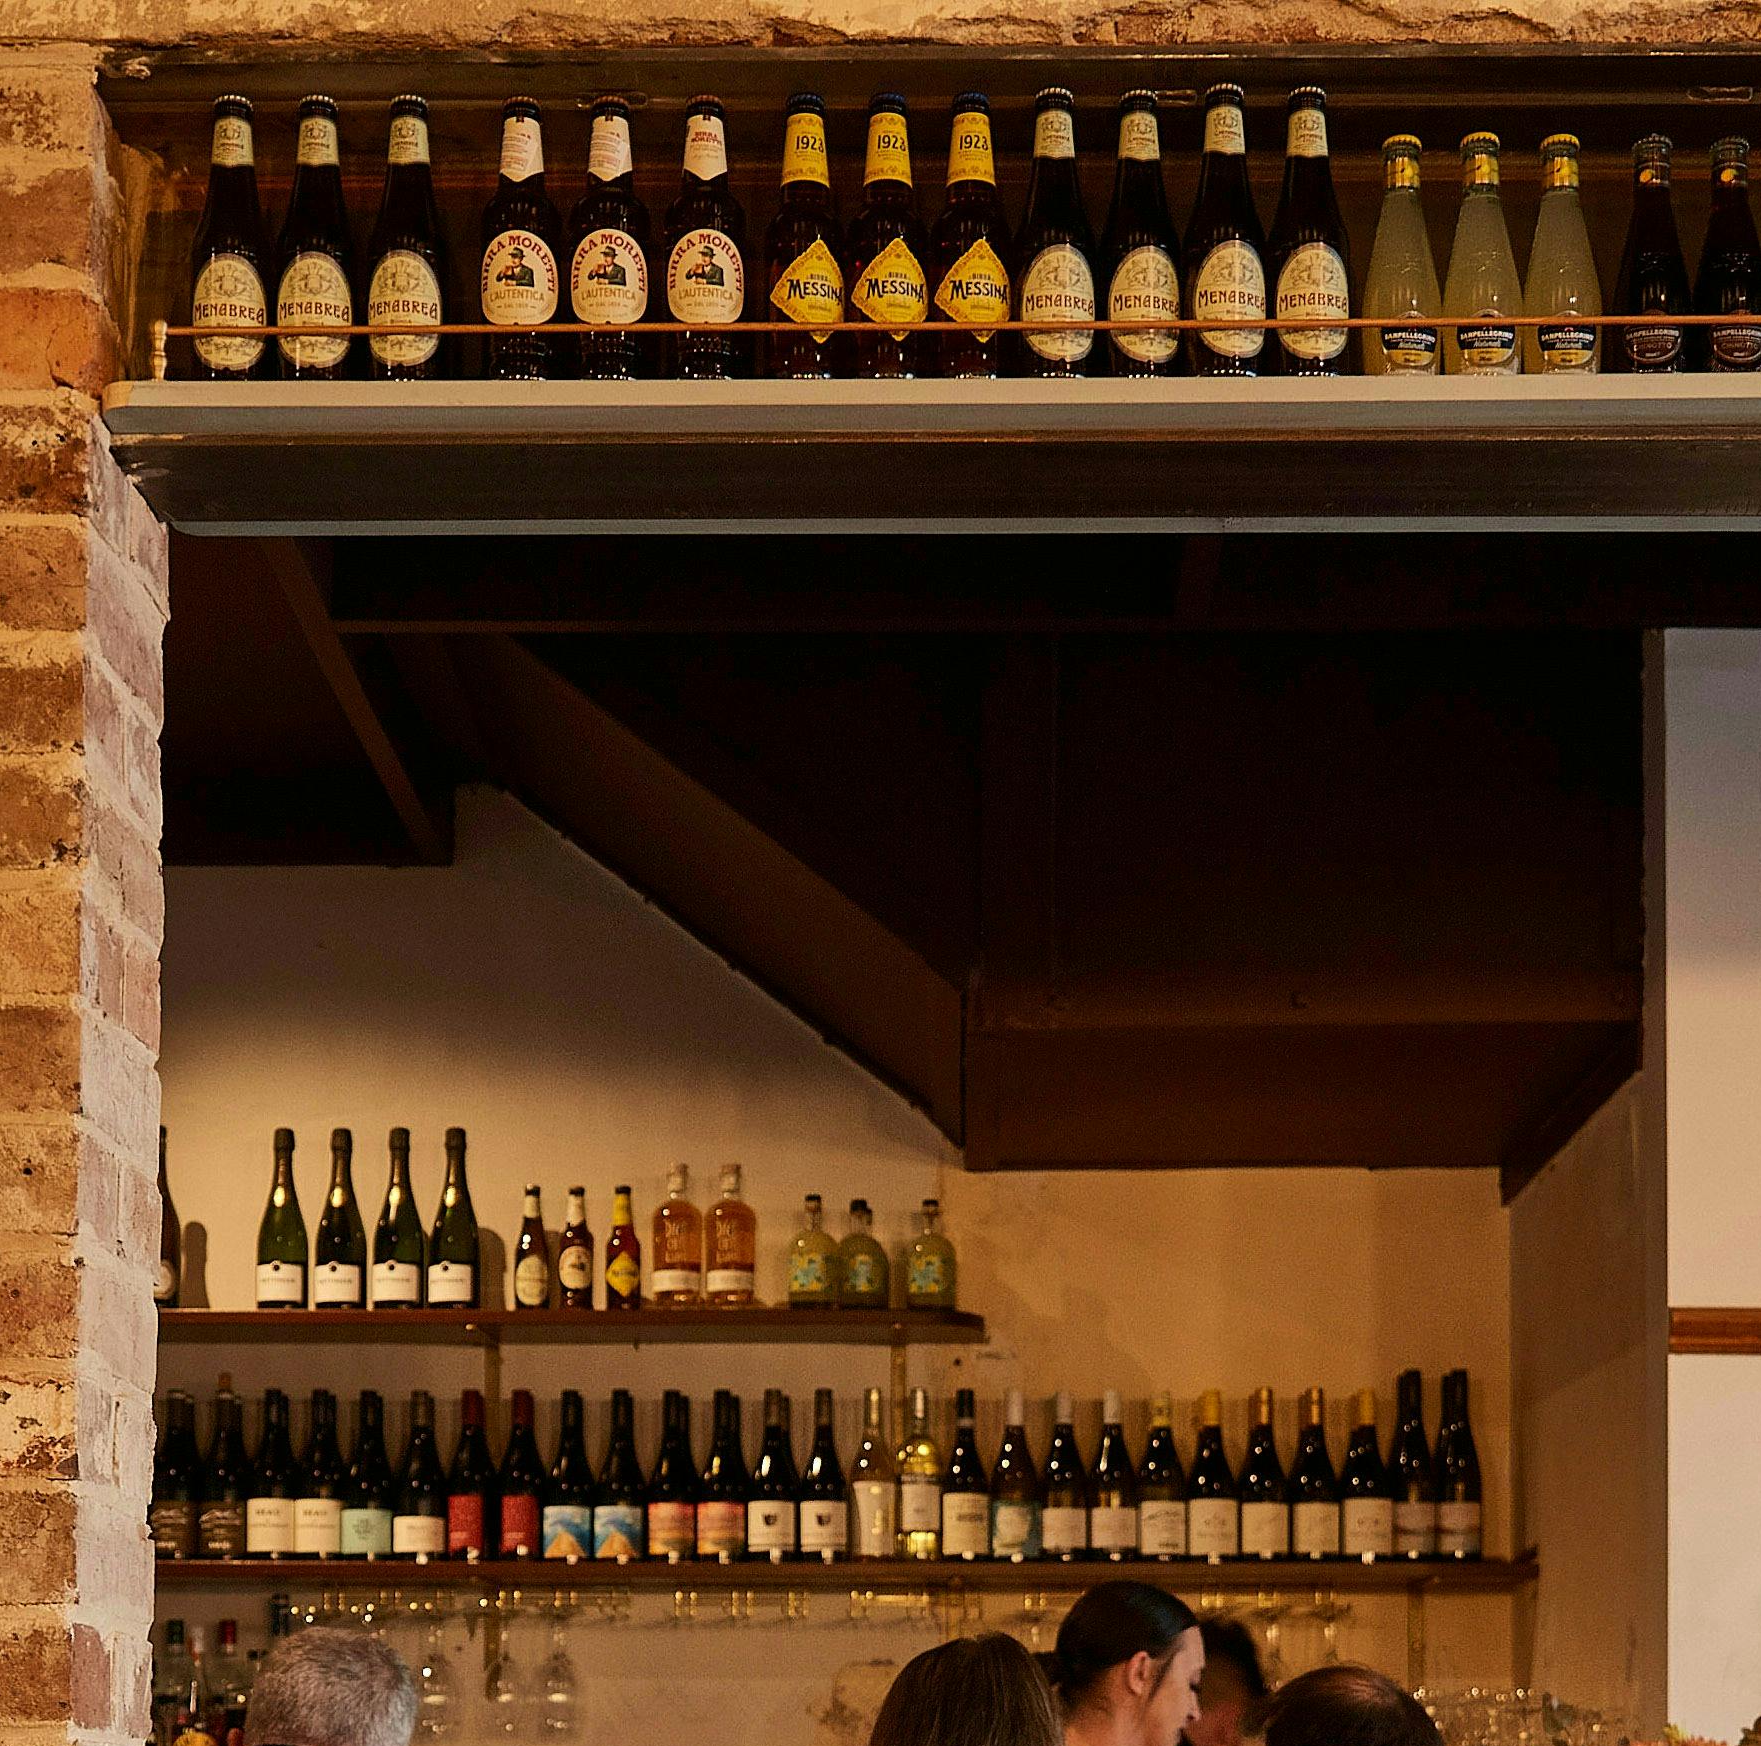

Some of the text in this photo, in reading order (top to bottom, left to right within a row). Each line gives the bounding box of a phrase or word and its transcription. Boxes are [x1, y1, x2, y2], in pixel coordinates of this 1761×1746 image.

[796, 135, 824, 153] 1923
[877, 134, 907, 152] 1923
[959, 134, 988, 152] 1923
[865, 277, 925, 305] MESSINA
[949, 279, 1008, 306] MESSINA
[194, 303, 265, 325] MENABREA
[279, 301, 350, 323] MENABREA
[369, 300, 439, 320] MENABREA
[1025, 294, 1094, 318] MENABREA
